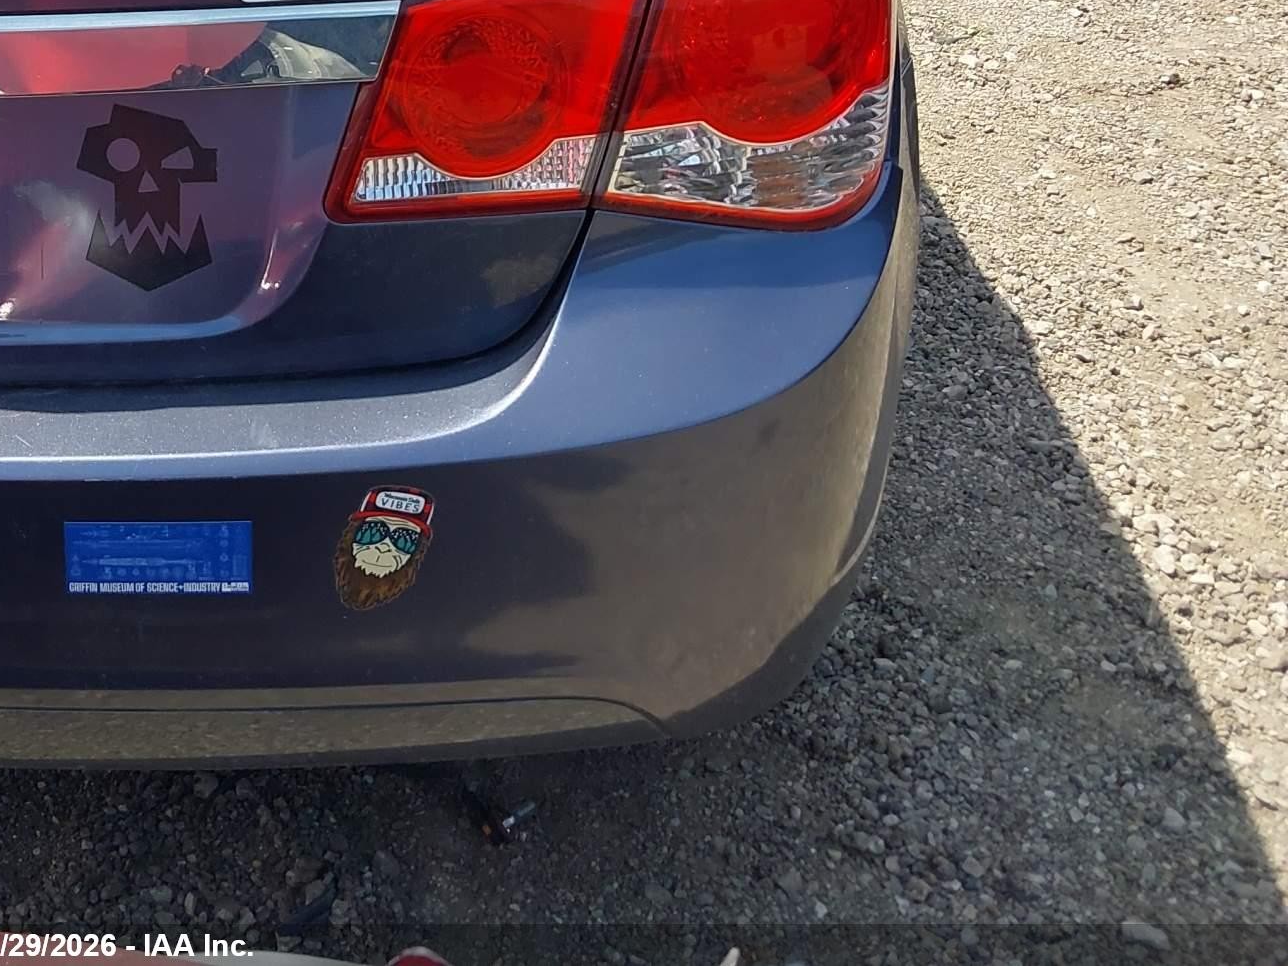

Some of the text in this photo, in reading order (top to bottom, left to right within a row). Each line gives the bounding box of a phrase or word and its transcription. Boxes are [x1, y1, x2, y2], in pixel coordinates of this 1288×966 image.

[381, 497, 420, 513] VIBES
[69, 582, 98, 592] GRIFFIN
[99, 582, 134, 592] MUSEUM
[135, 582, 145, 592] OF
